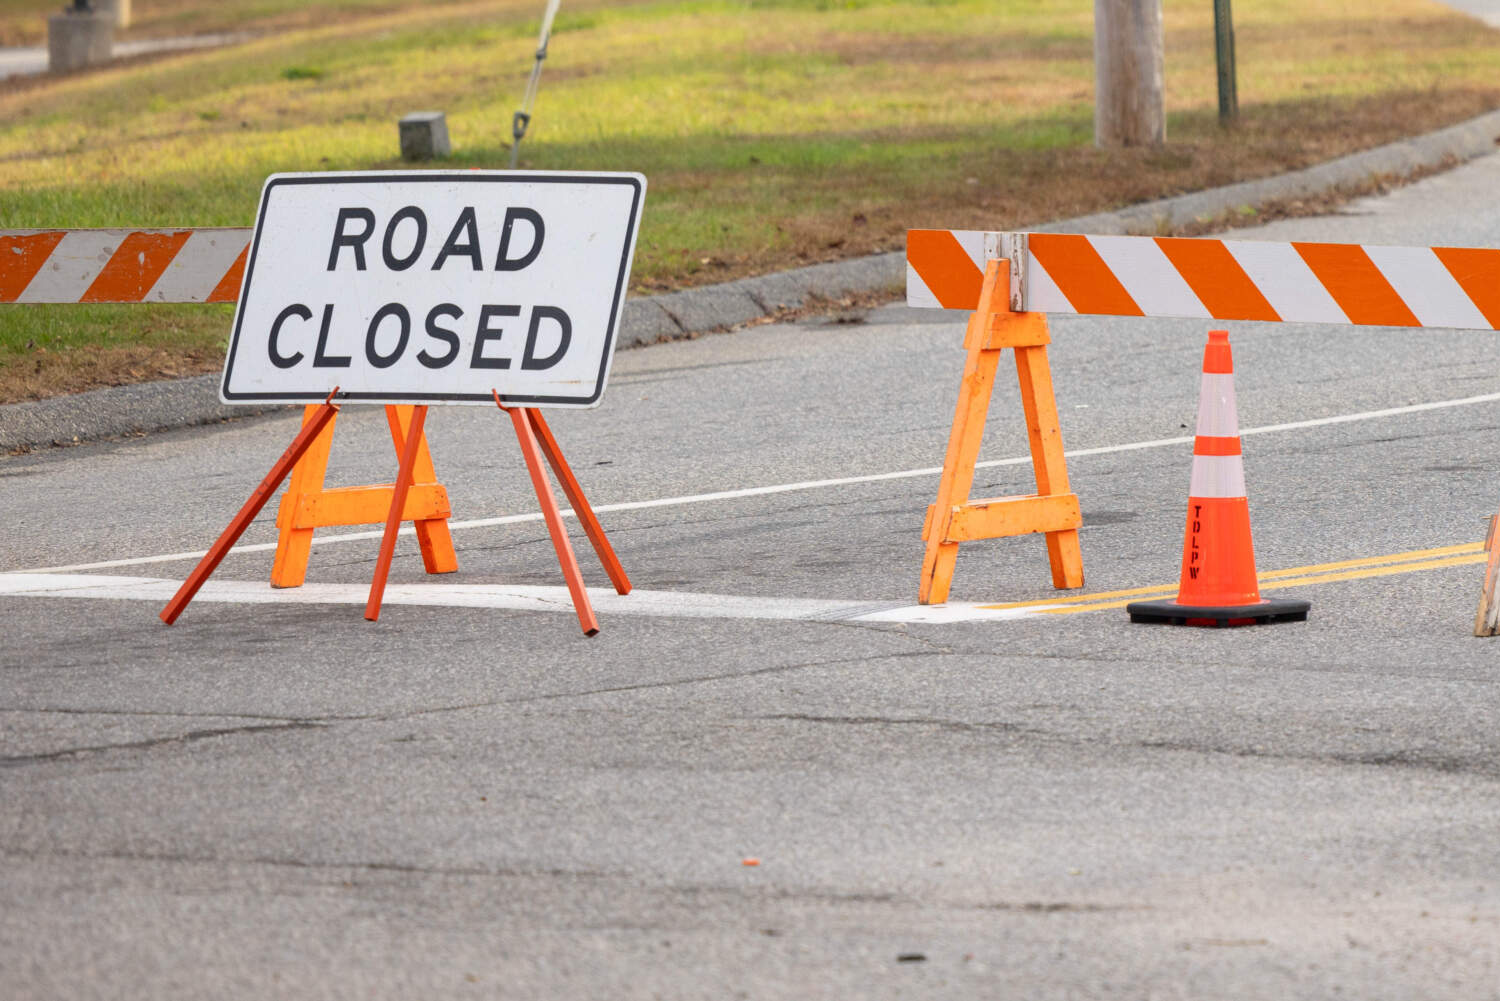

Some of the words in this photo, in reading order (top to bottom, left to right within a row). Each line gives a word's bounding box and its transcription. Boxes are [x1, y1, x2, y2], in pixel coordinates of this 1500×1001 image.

[326, 205, 546, 272] ROAD
[267, 302, 573, 371] CLOSED
[1190, 505, 1202, 580] TDLPW
